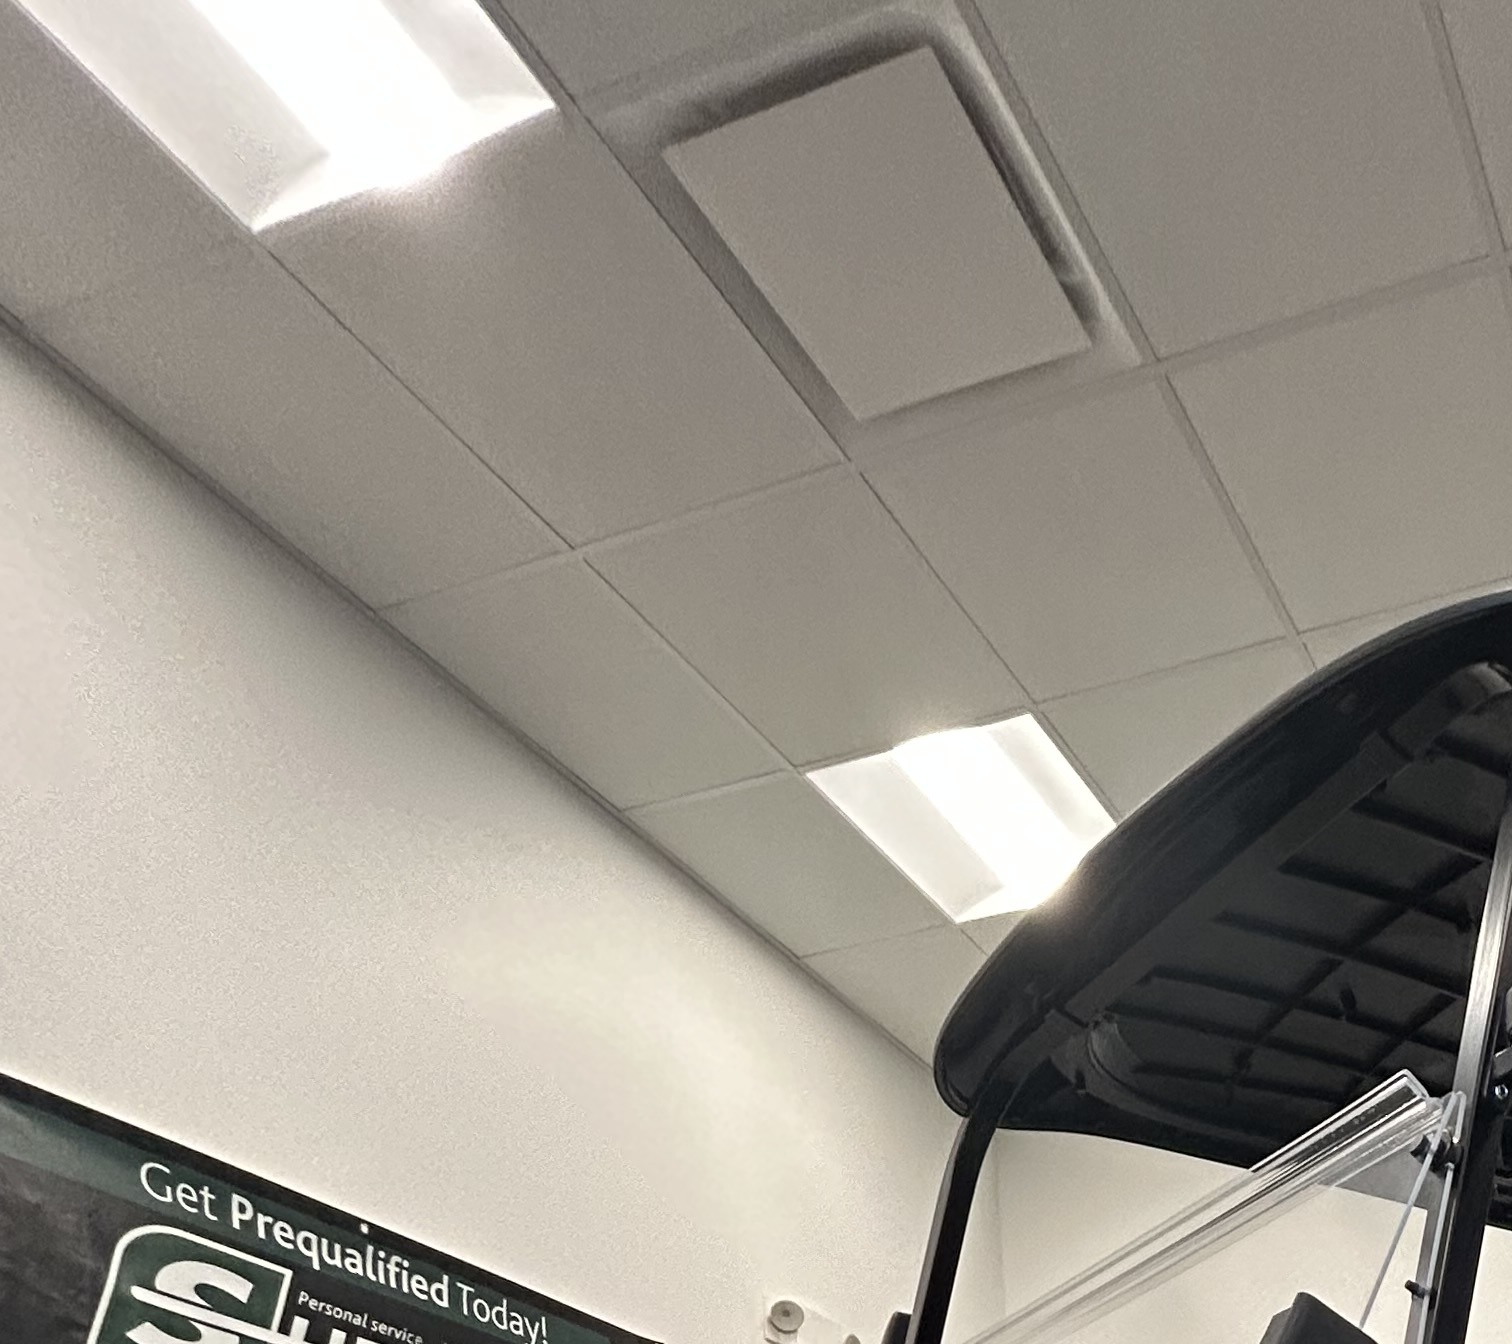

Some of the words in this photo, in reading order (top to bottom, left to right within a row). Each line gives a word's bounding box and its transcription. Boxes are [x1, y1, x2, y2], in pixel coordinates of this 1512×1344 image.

[140, 1162, 218, 1221] Get
[231, 1193, 449, 1308] Prequalified
[298, 1291, 367, 1329] Personal
